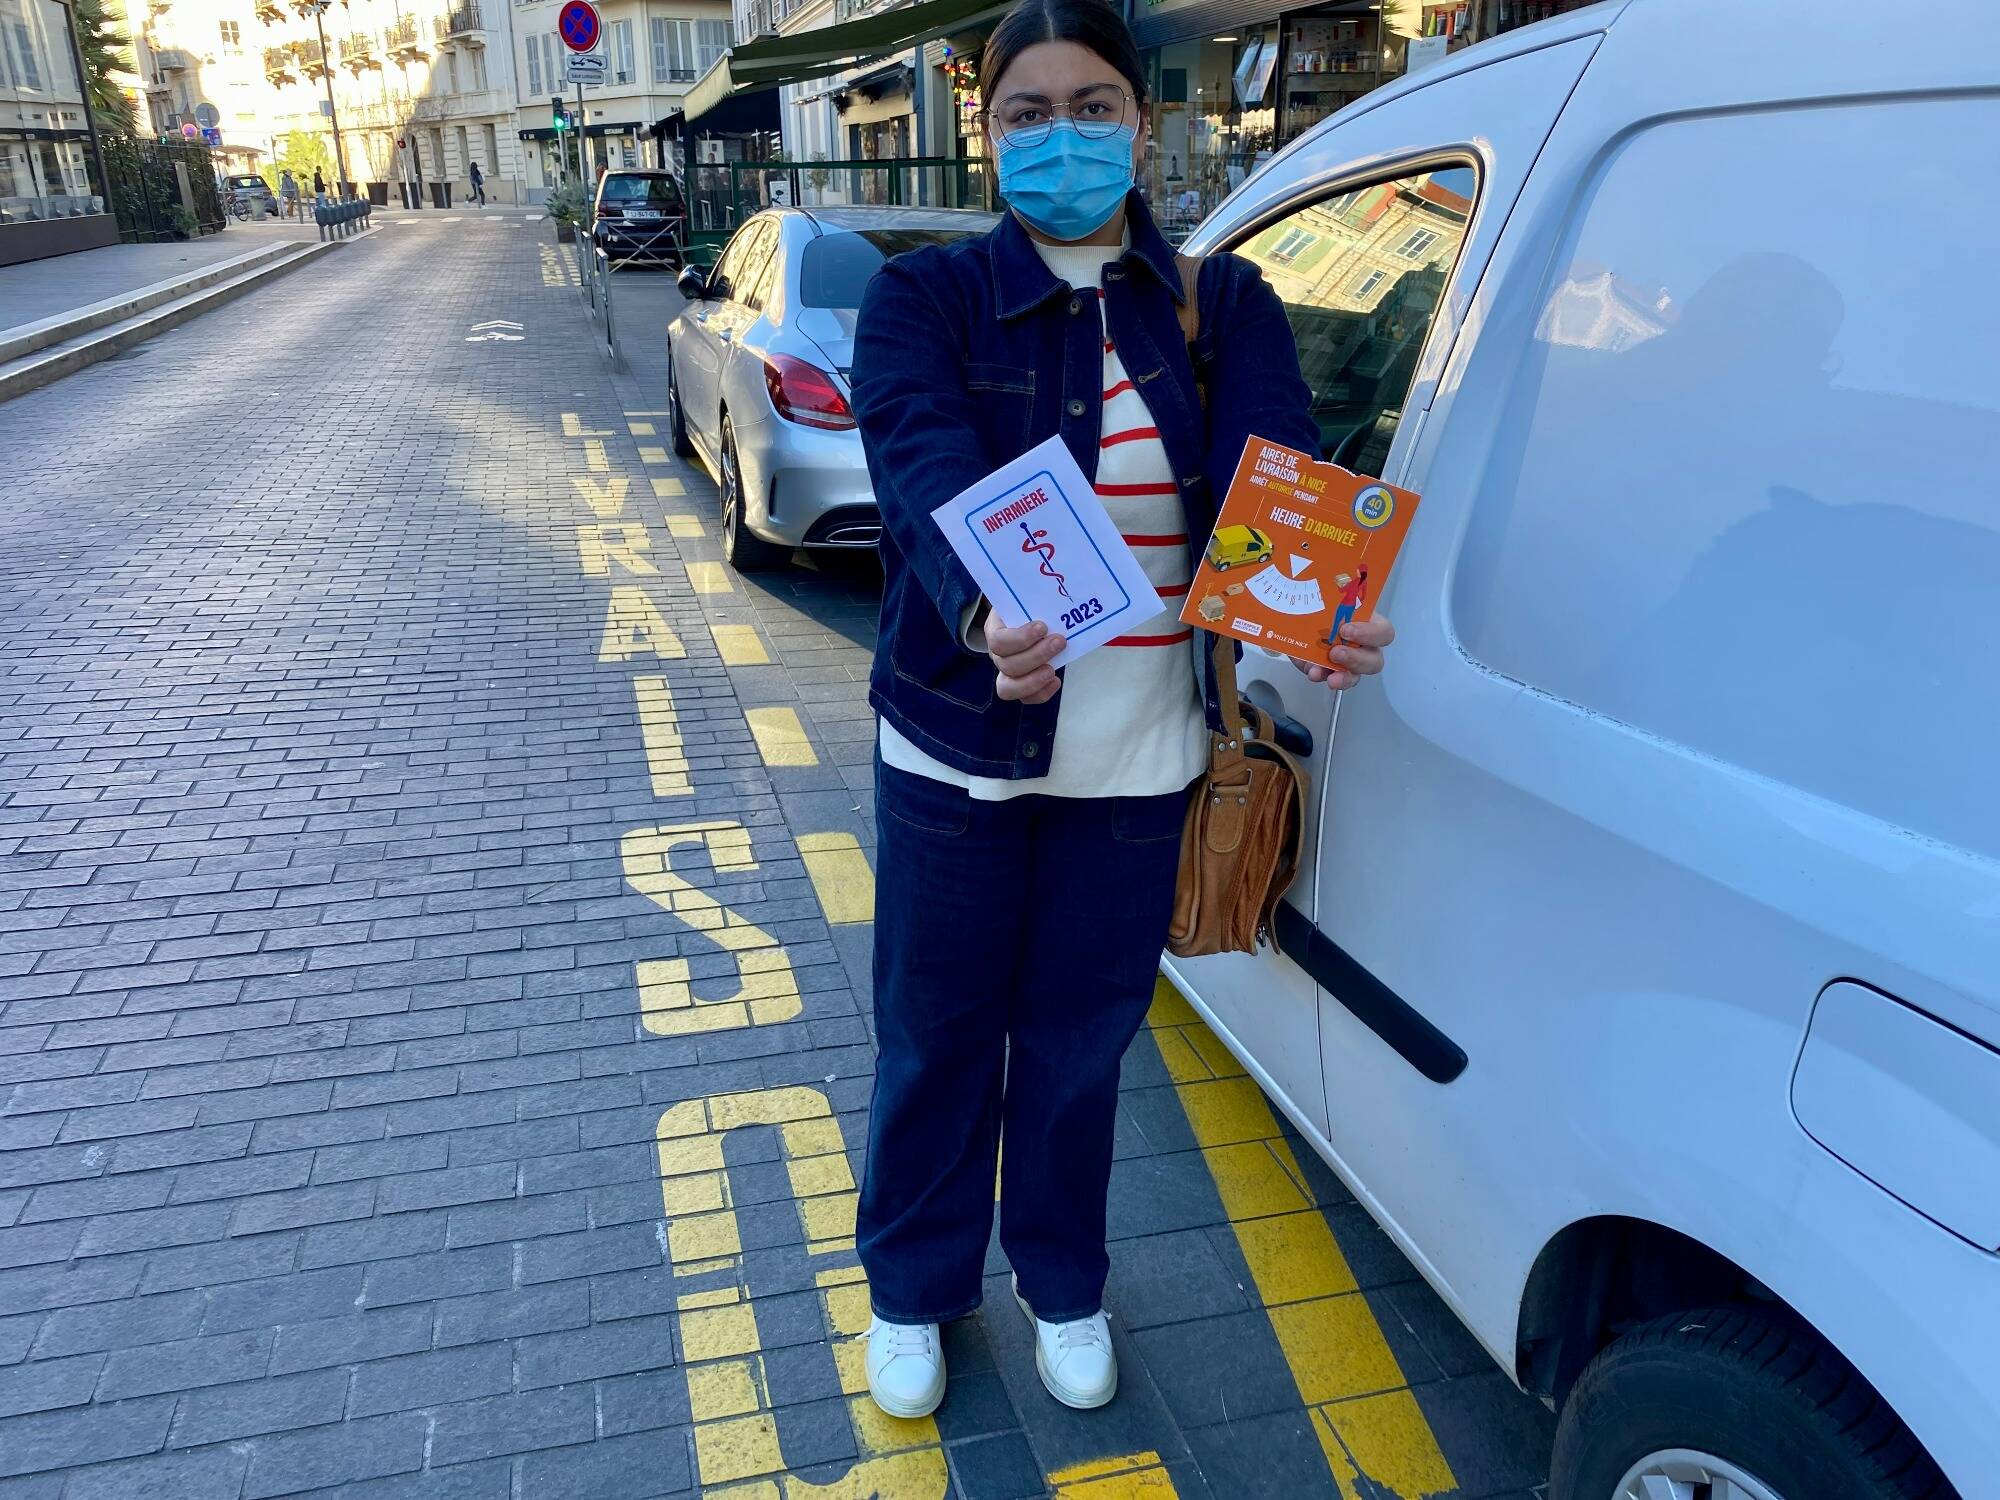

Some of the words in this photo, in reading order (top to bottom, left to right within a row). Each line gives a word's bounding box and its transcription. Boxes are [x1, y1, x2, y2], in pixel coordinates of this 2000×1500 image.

[1259, 446, 1285, 465] AIRES
[1285, 455, 1299, 469] DE
[1249, 474, 1269, 488] ARRÊT
[1293, 489, 1319, 505] PENDANT
[1254, 459, 1301, 483] LIVRAISON
[1298, 472, 1306, 487] À
[1306, 477, 1328, 493] NICE
[982, 487, 1049, 533] INFIRMIÈRE
[1364, 507, 1377, 517] min
[1367, 497, 1382, 511] 40
[1269, 506, 1306, 530] HEURE
[1304, 517, 1358, 547] D'ARRIVÉE
[1060, 597, 1104, 630] 2023
